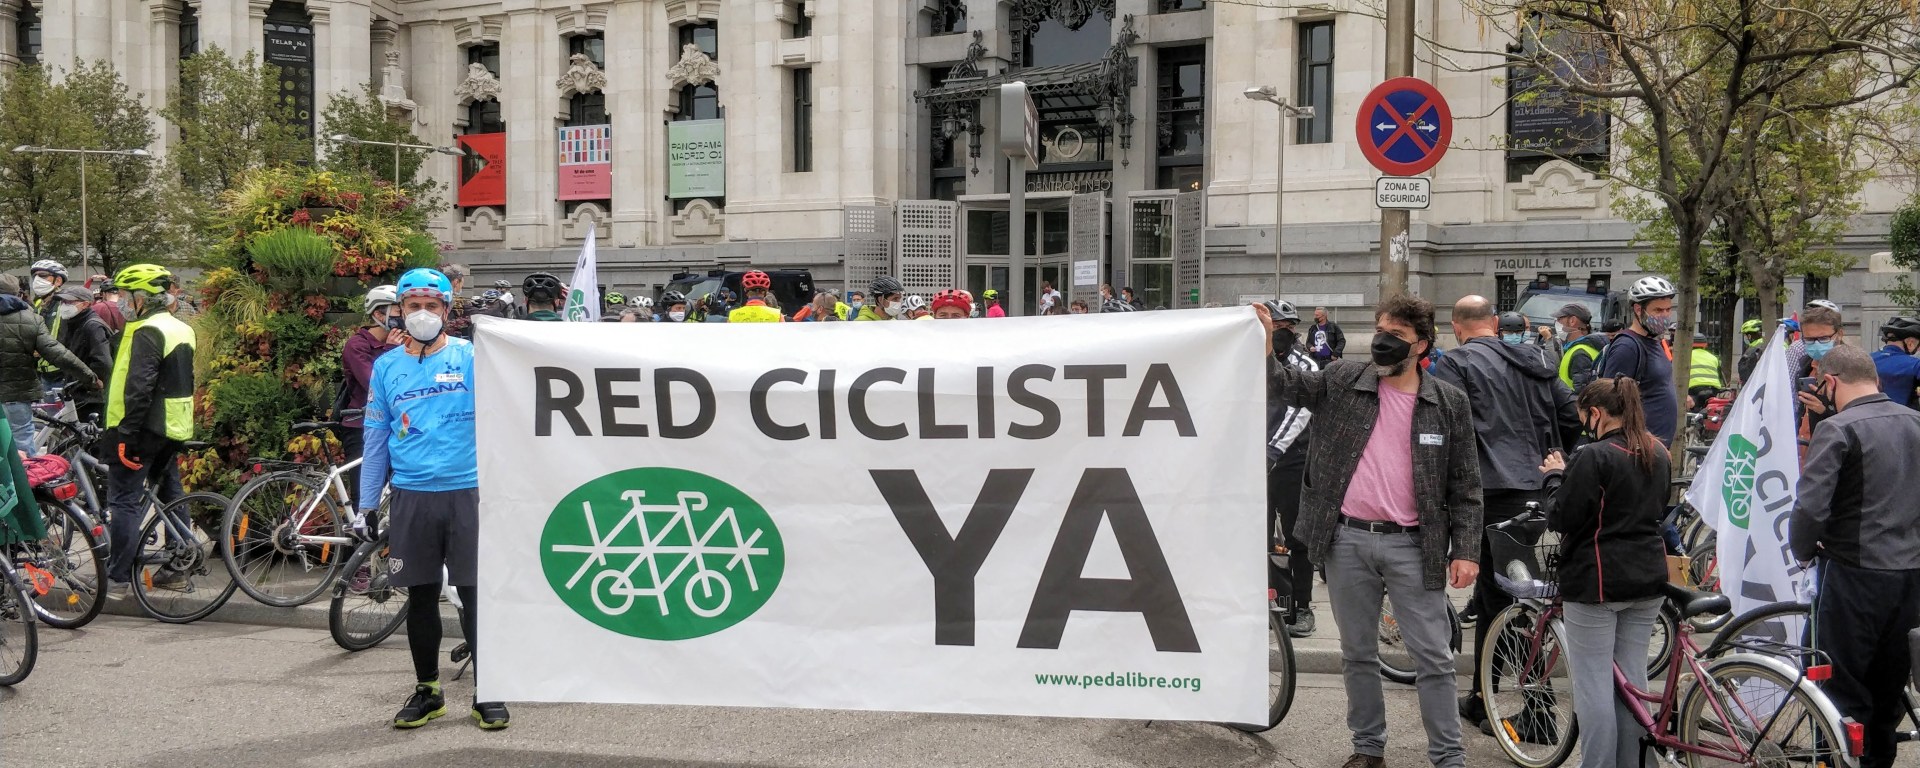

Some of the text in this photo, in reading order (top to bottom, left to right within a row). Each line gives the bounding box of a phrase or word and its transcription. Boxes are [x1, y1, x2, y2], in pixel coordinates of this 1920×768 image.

[671, 141, 722, 150] PANORAMA
[671, 151, 705, 160] MADRID
[1384, 182, 1420, 191] ZONA DE
[1379, 194, 1427, 203] SEGURIDAD
[1494, 257, 1612, 269] TAQUILLA TICKETS
[393, 381, 469, 406] ASTANA
[534, 363, 1198, 441] RED CICLISTA
[869, 467, 1202, 652] YA
[1034, 671, 1202, 692] www.pedalibre.org
